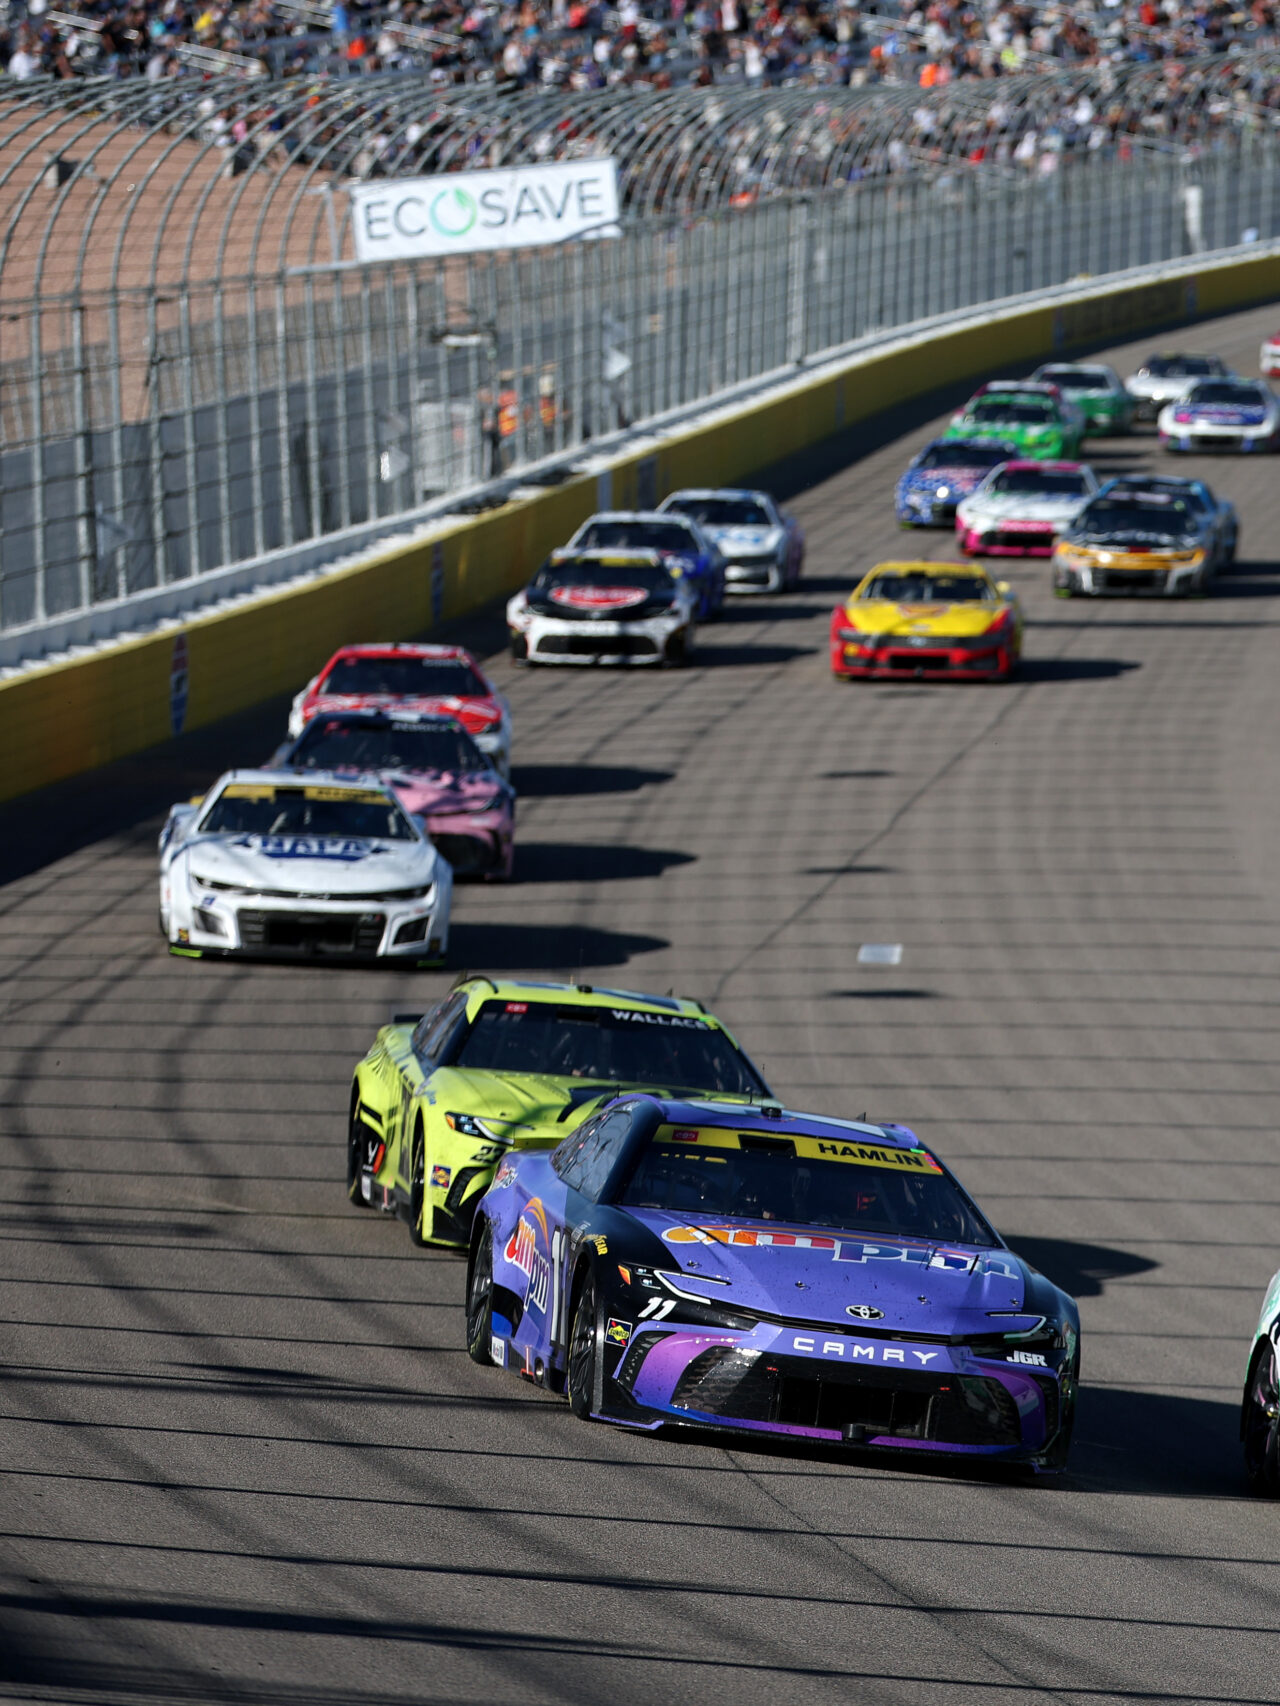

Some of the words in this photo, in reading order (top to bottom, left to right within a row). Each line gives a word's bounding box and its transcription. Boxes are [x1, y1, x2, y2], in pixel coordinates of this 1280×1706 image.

[364, 178, 604, 240] ECOSAVE
[611, 1009, 709, 1030] WALLACE
[818, 1142, 924, 1168] HAMLIN
[637, 1296, 677, 1321] 11
[793, 1337, 938, 1366] CAMRY
[1006, 1350, 1046, 1368] JGR
